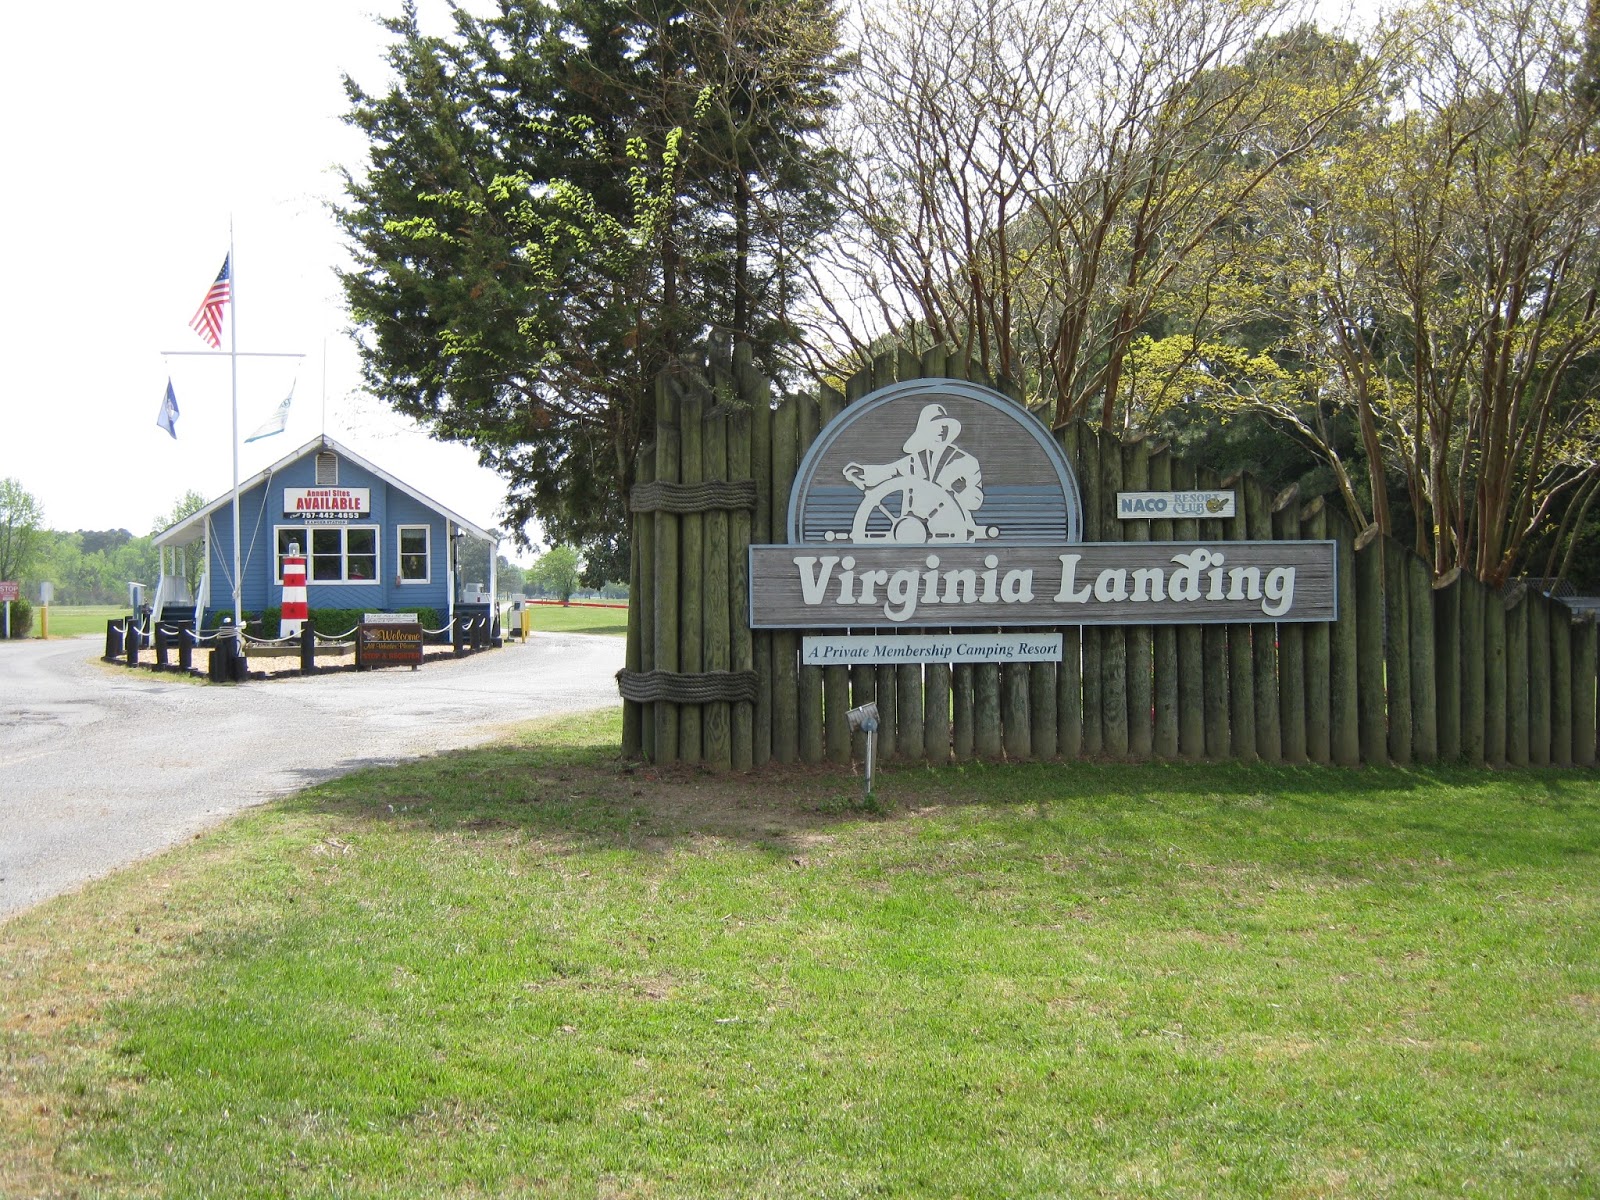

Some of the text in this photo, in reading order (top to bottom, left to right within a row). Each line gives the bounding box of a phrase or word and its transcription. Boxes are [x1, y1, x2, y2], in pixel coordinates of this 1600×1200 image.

[296, 497, 361, 510] AVAILABLE
[1121, 493, 1220, 513] NACO RESORT
[1172, 502, 1205, 515] CLUB
[792, 548, 1297, 622] Virginia Landing
[379, 629, 420, 641] Welcome
[808, 641, 1058, 659] A Private Membership Camping Resort
